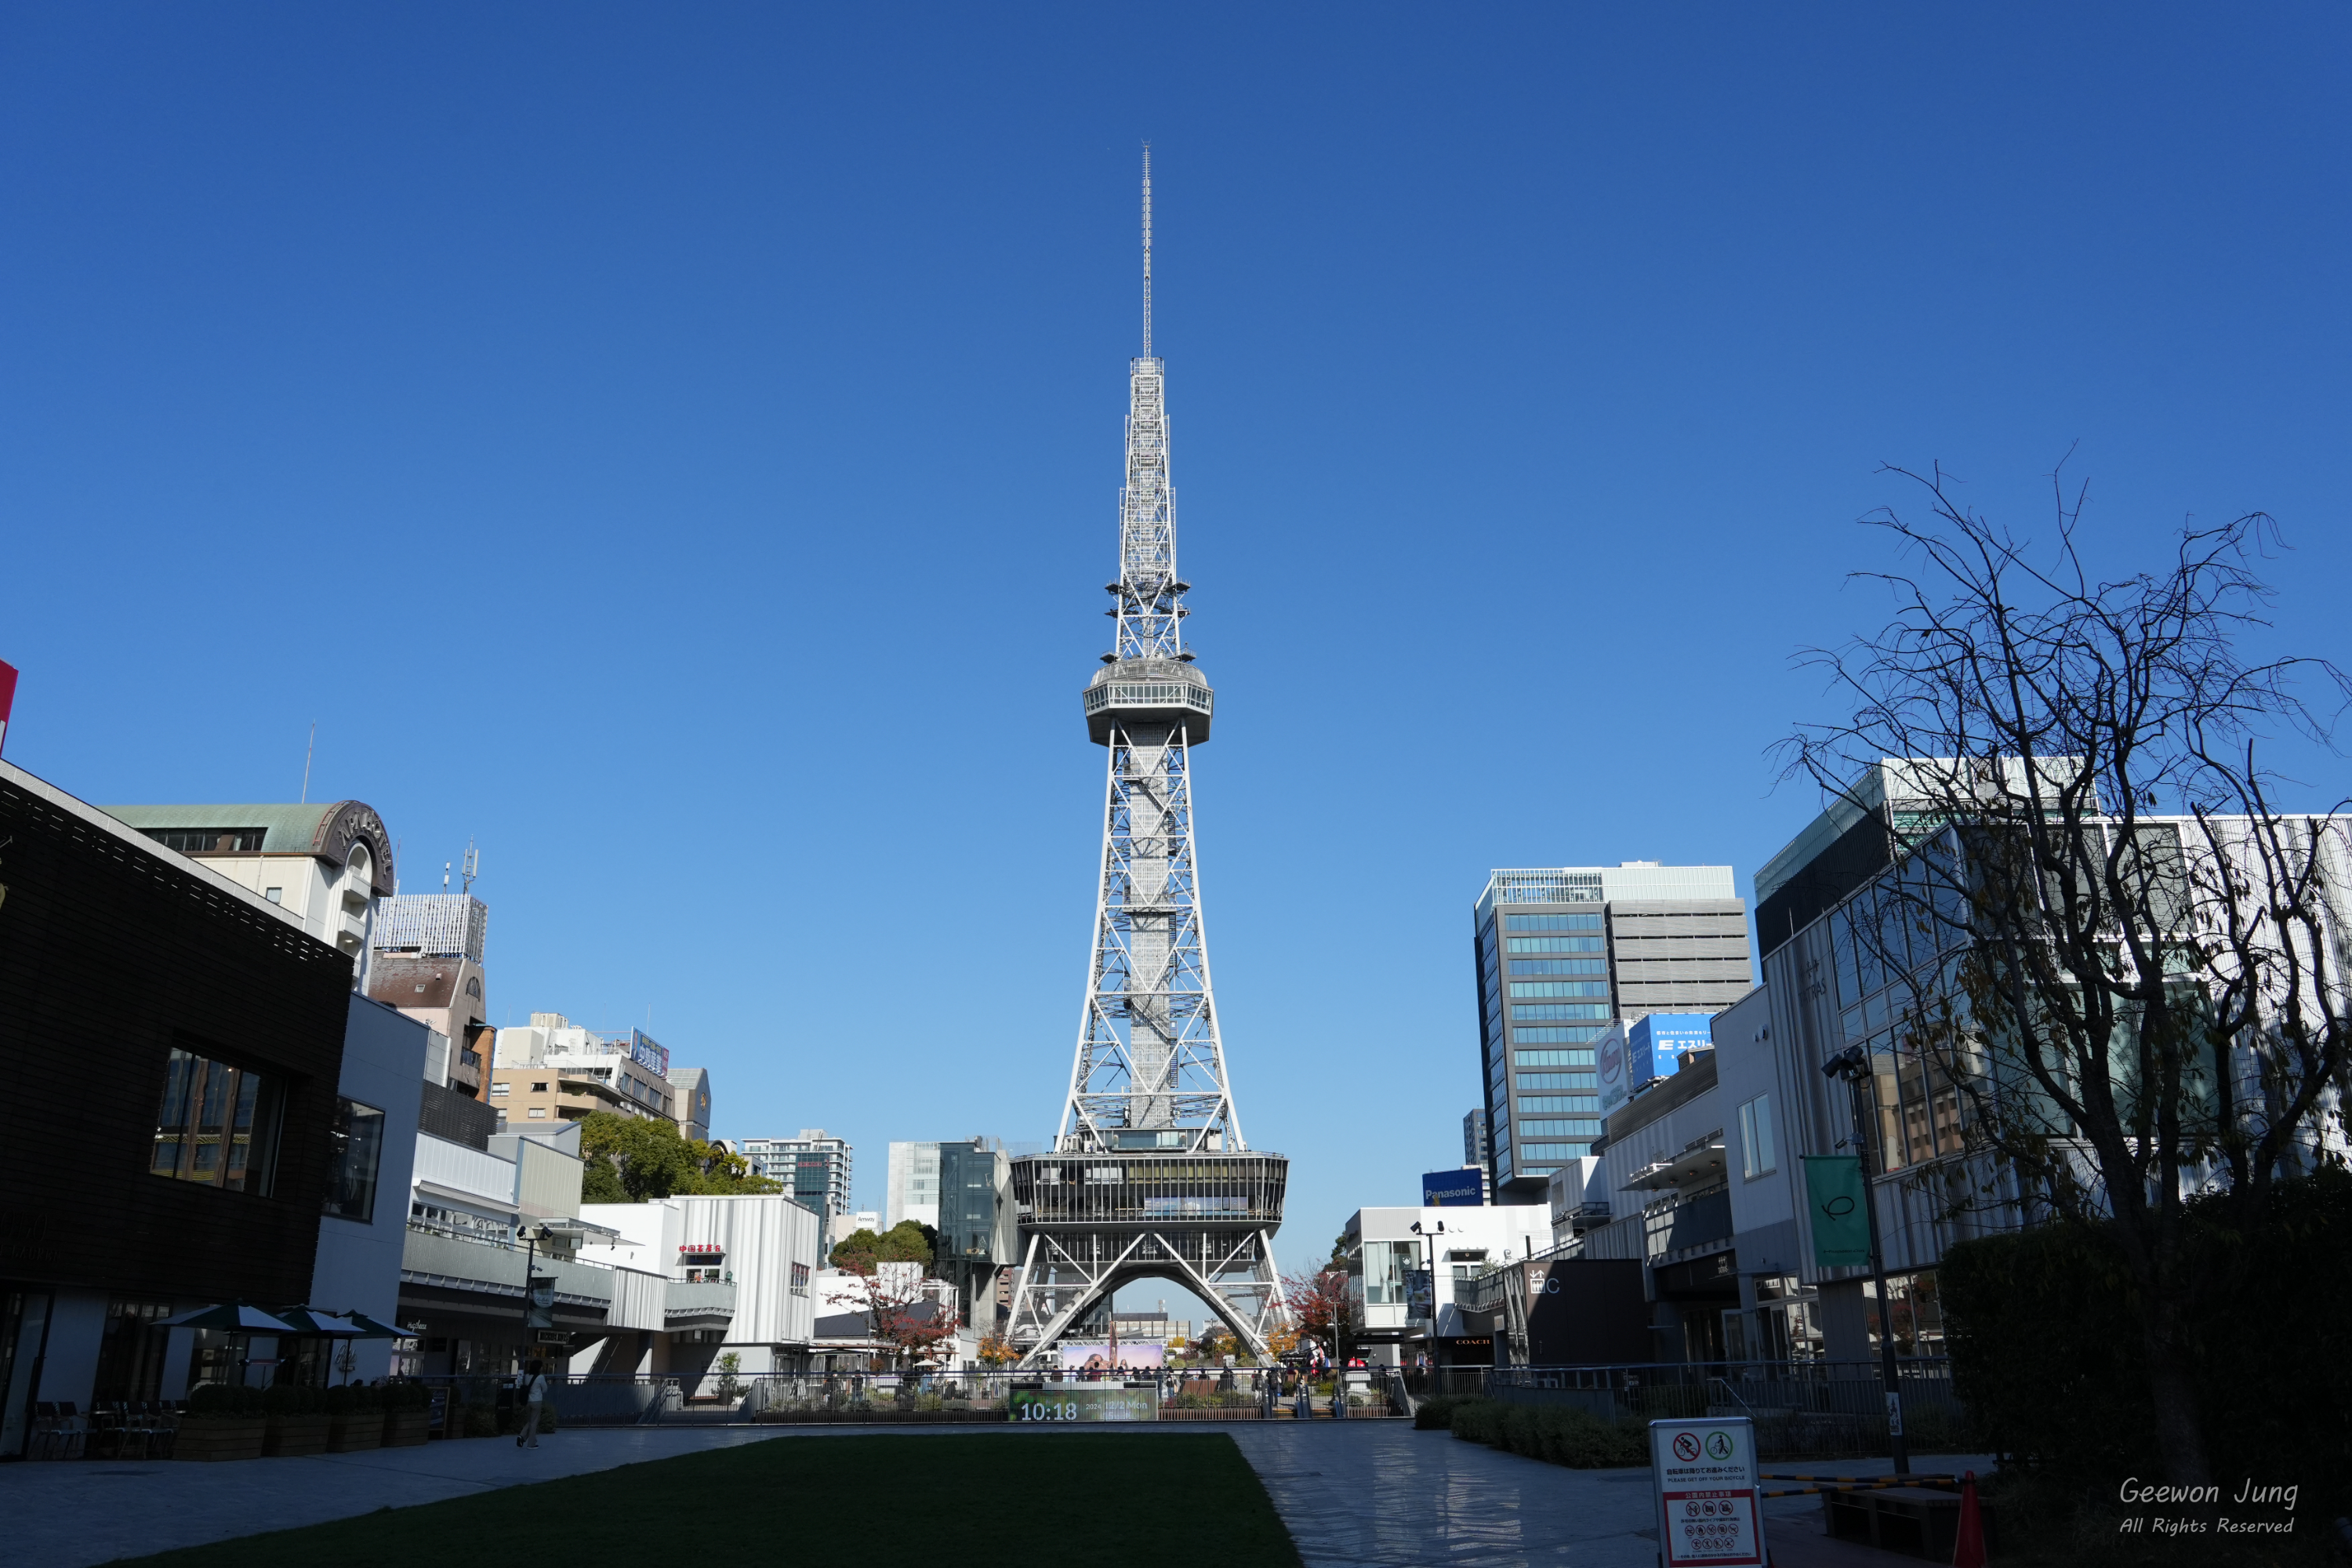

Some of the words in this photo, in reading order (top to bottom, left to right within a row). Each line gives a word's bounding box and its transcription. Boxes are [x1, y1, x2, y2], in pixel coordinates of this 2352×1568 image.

[361, 810, 392, 876] HOTEL
[1425, 1186, 1476, 1200] Panasonic
[1546, 1277, 1560, 1294] C
[1022, 1403, 1077, 1421] 10:18
[1667, 1466, 1745, 1475] 自転車は降りてお進みください
